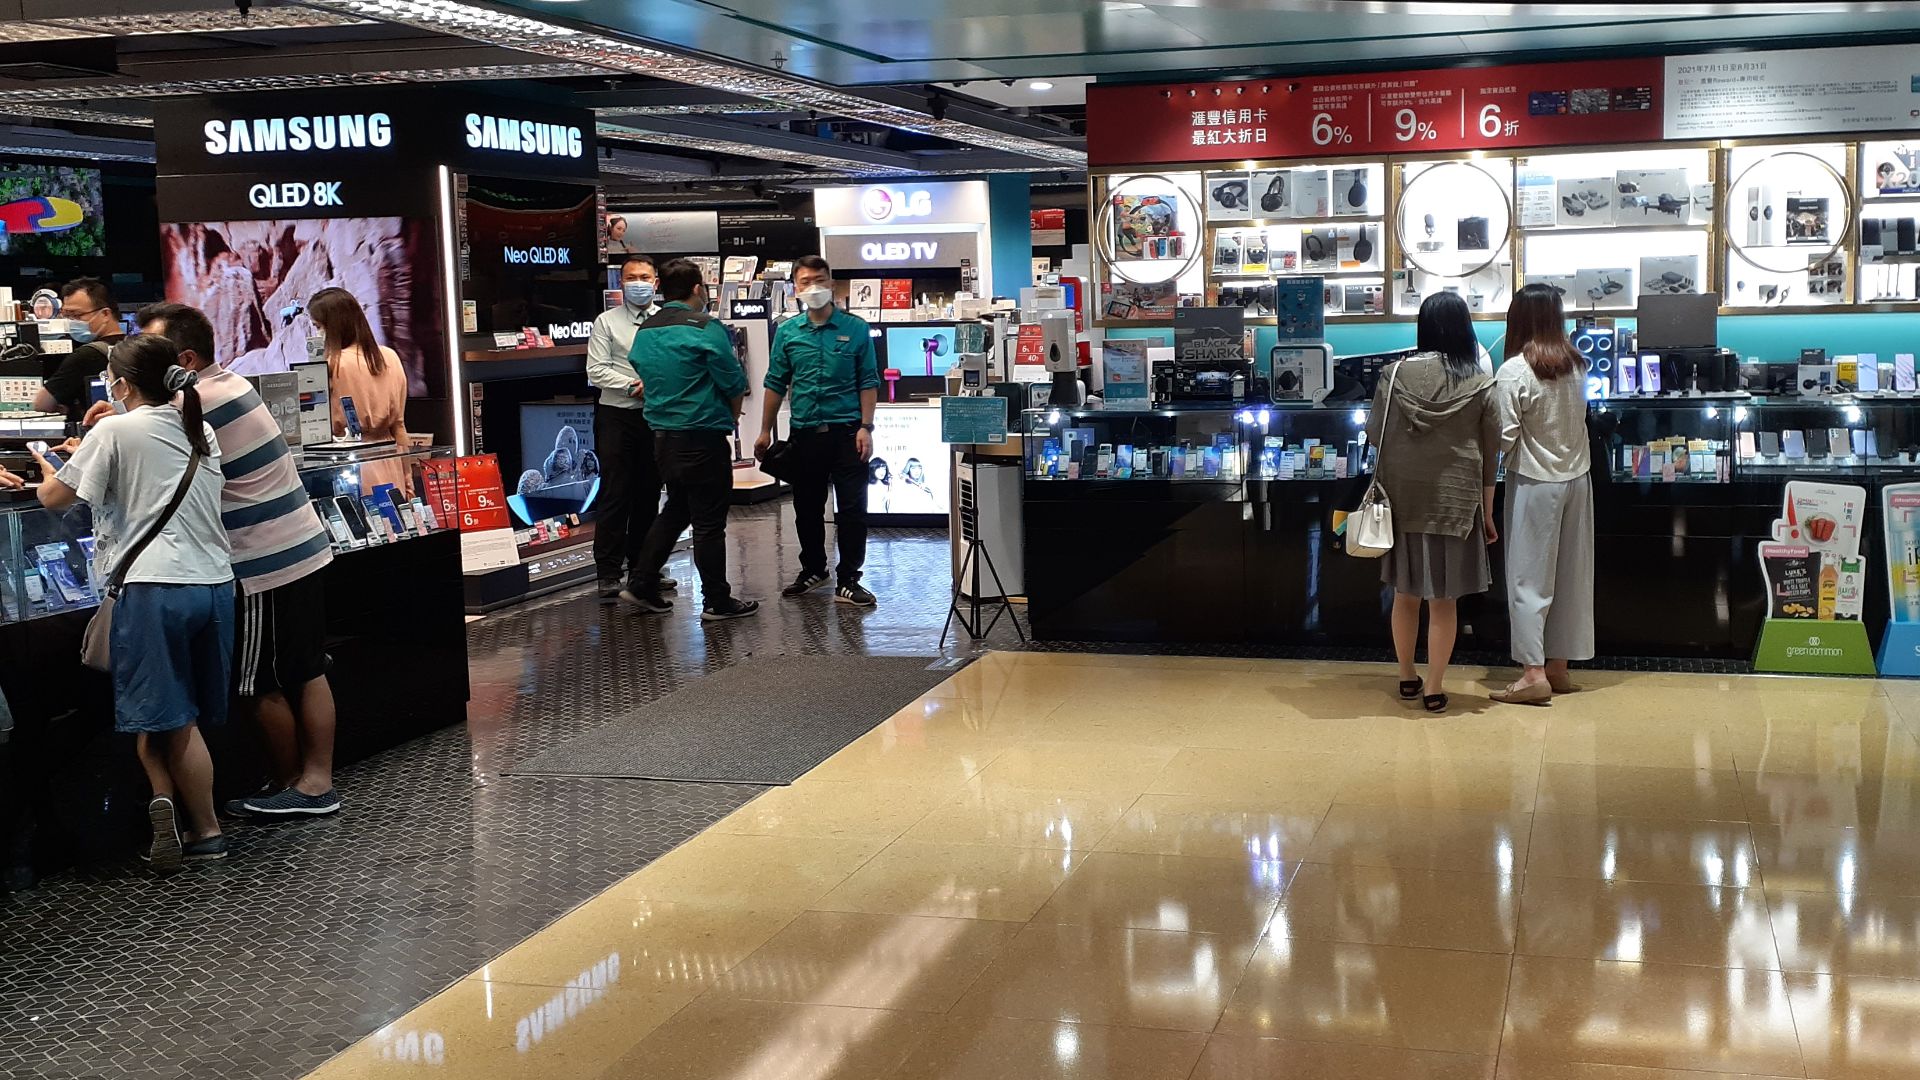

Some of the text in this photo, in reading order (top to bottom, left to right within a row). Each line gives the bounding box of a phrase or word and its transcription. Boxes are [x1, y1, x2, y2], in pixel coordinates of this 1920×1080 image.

[1312, 112, 1353, 146] 6%
[1395, 108, 1437, 142] 9%
[1479, 103, 1519, 138] 6折
[204, 113, 392, 155] SAMSUNG
[465, 113, 583, 158] SAMSUNG
[1191, 128, 1267, 146] 最紅大折日
[249, 181, 343, 208] QLED 8K
[895, 190, 932, 216] LG
[504, 246, 571, 264] Neo QLED 8K
[861, 241, 938, 261] OLED TV
[734, 302, 765, 316] dyson
[549, 323, 570, 339] Neo
[1184, 346, 1241, 359] SHARK
[1193, 338, 1230, 348] BLACK
